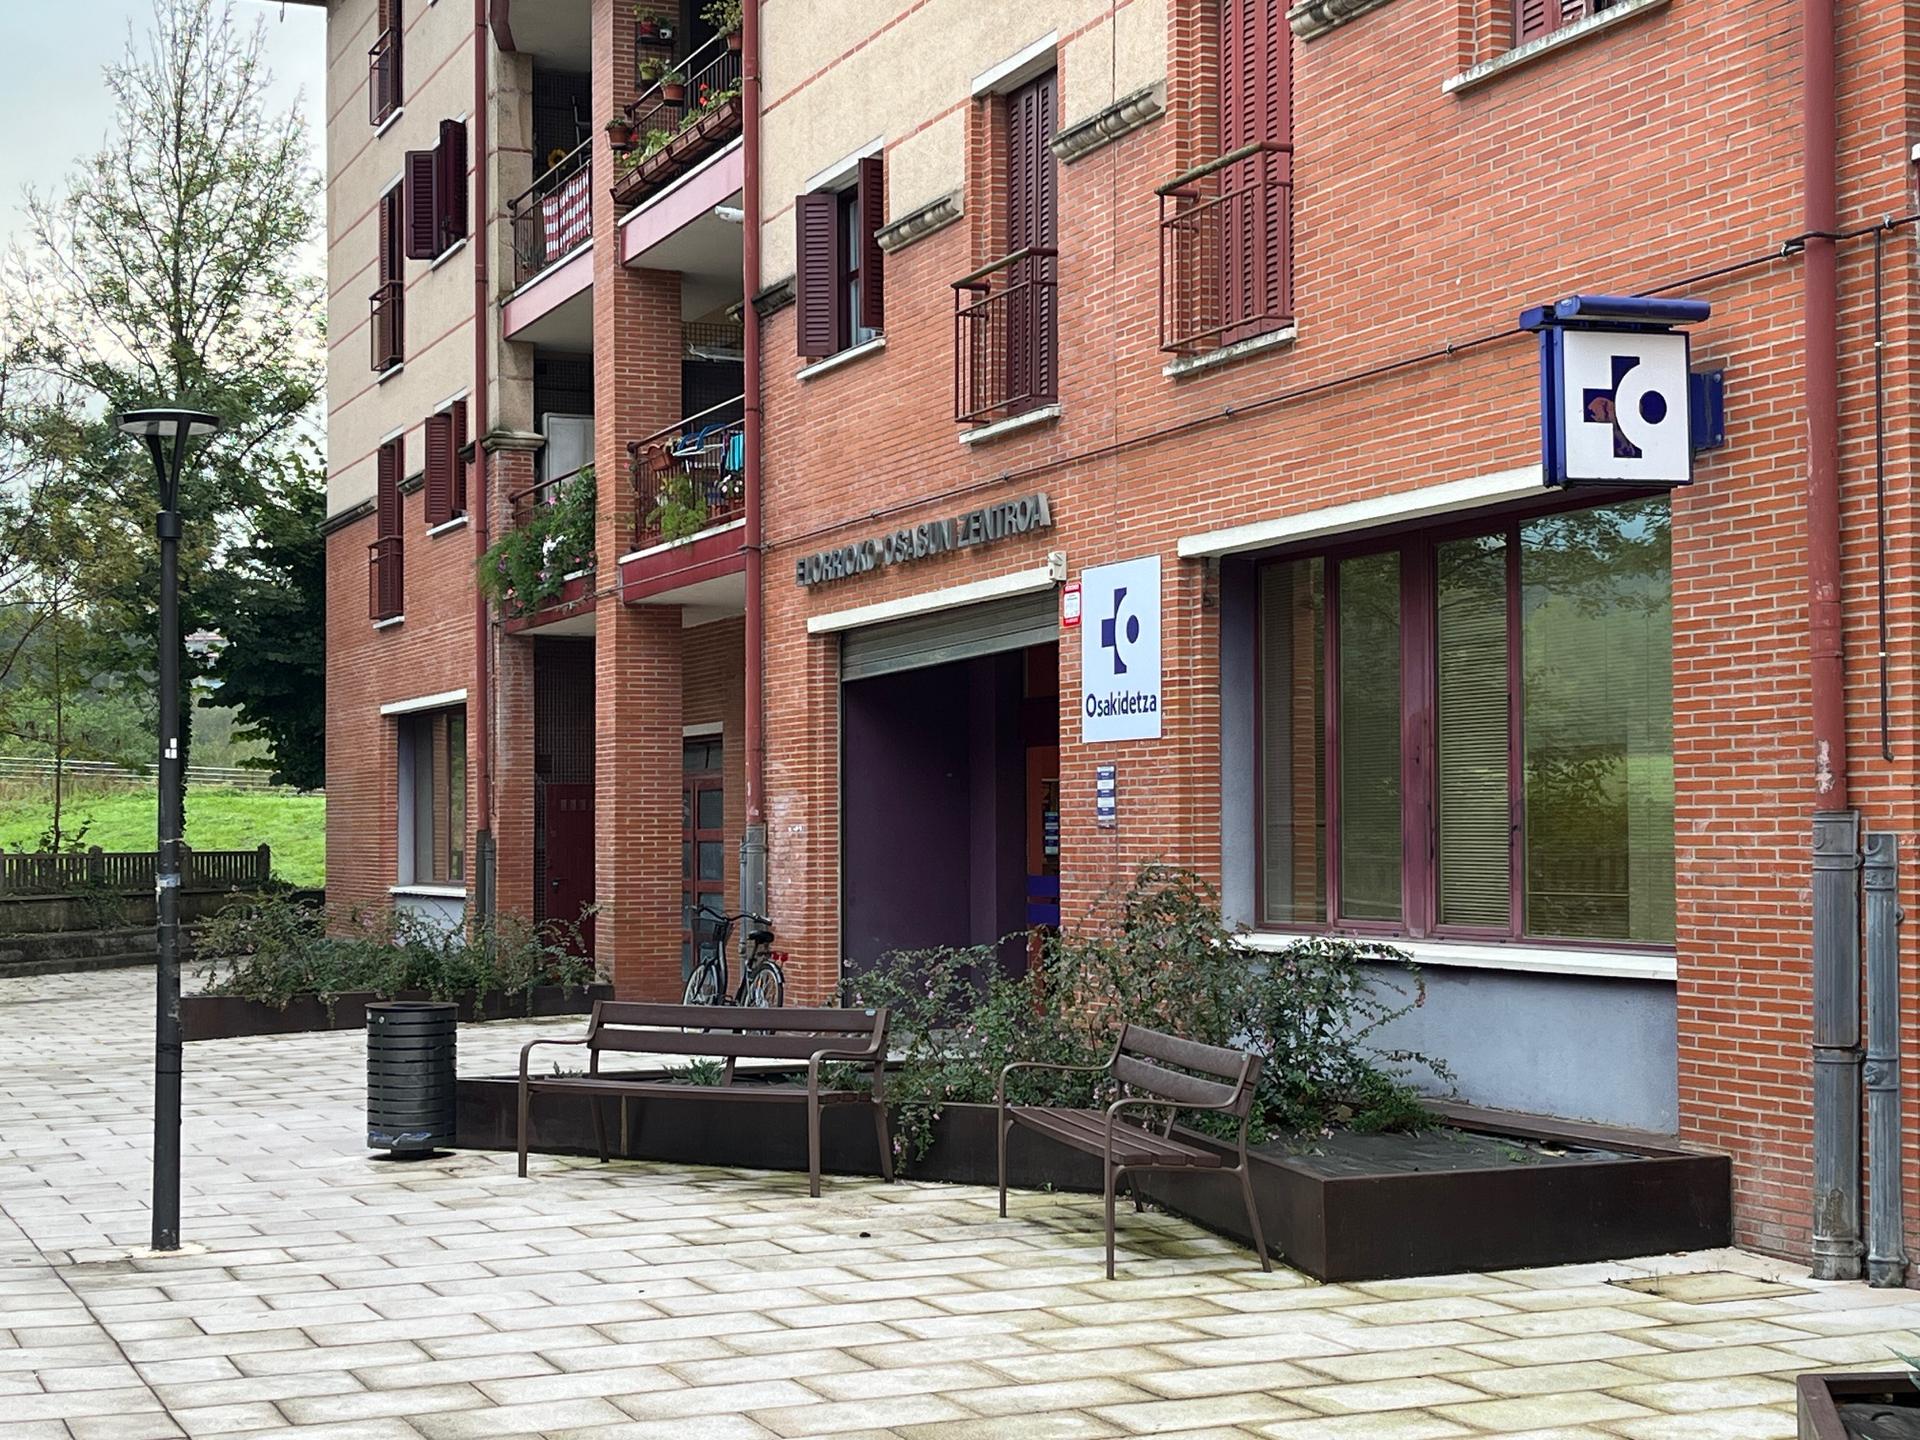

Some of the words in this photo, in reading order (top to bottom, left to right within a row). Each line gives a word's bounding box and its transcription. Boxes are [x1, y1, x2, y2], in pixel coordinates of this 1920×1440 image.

[796, 538, 878, 586] ELORRIOKO
[882, 518, 955, 565] OSASUN
[957, 492, 1052, 547] ZENTROA
[1086, 690, 1157, 718] Osakidetza
